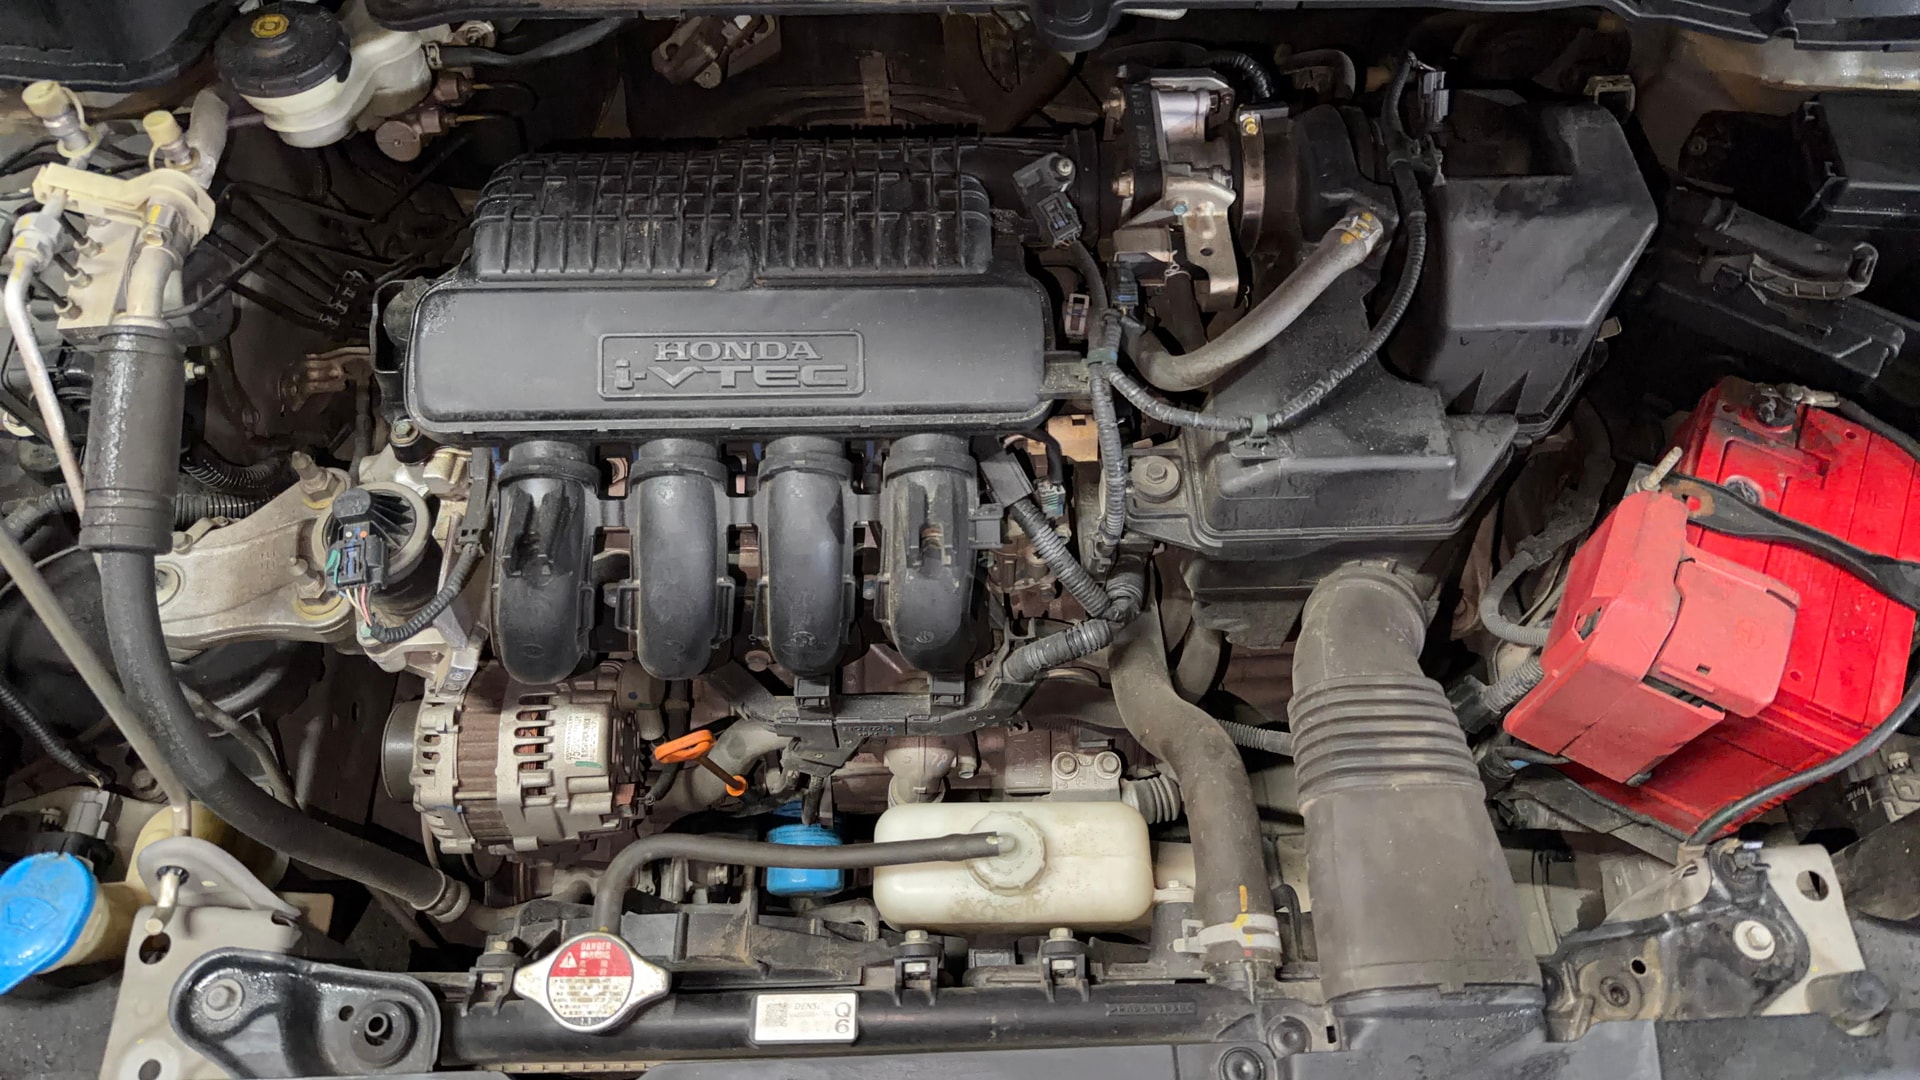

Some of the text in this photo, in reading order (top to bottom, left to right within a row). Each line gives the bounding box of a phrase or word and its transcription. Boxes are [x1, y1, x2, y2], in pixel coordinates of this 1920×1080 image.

[654, 341, 822, 361] HONDA
[614, 359, 848, 390] i-VTEC
[580, 942, 611, 951] DANGER
[835, 1002, 851, 1017] Q
[835, 1018, 850, 1033] 6
